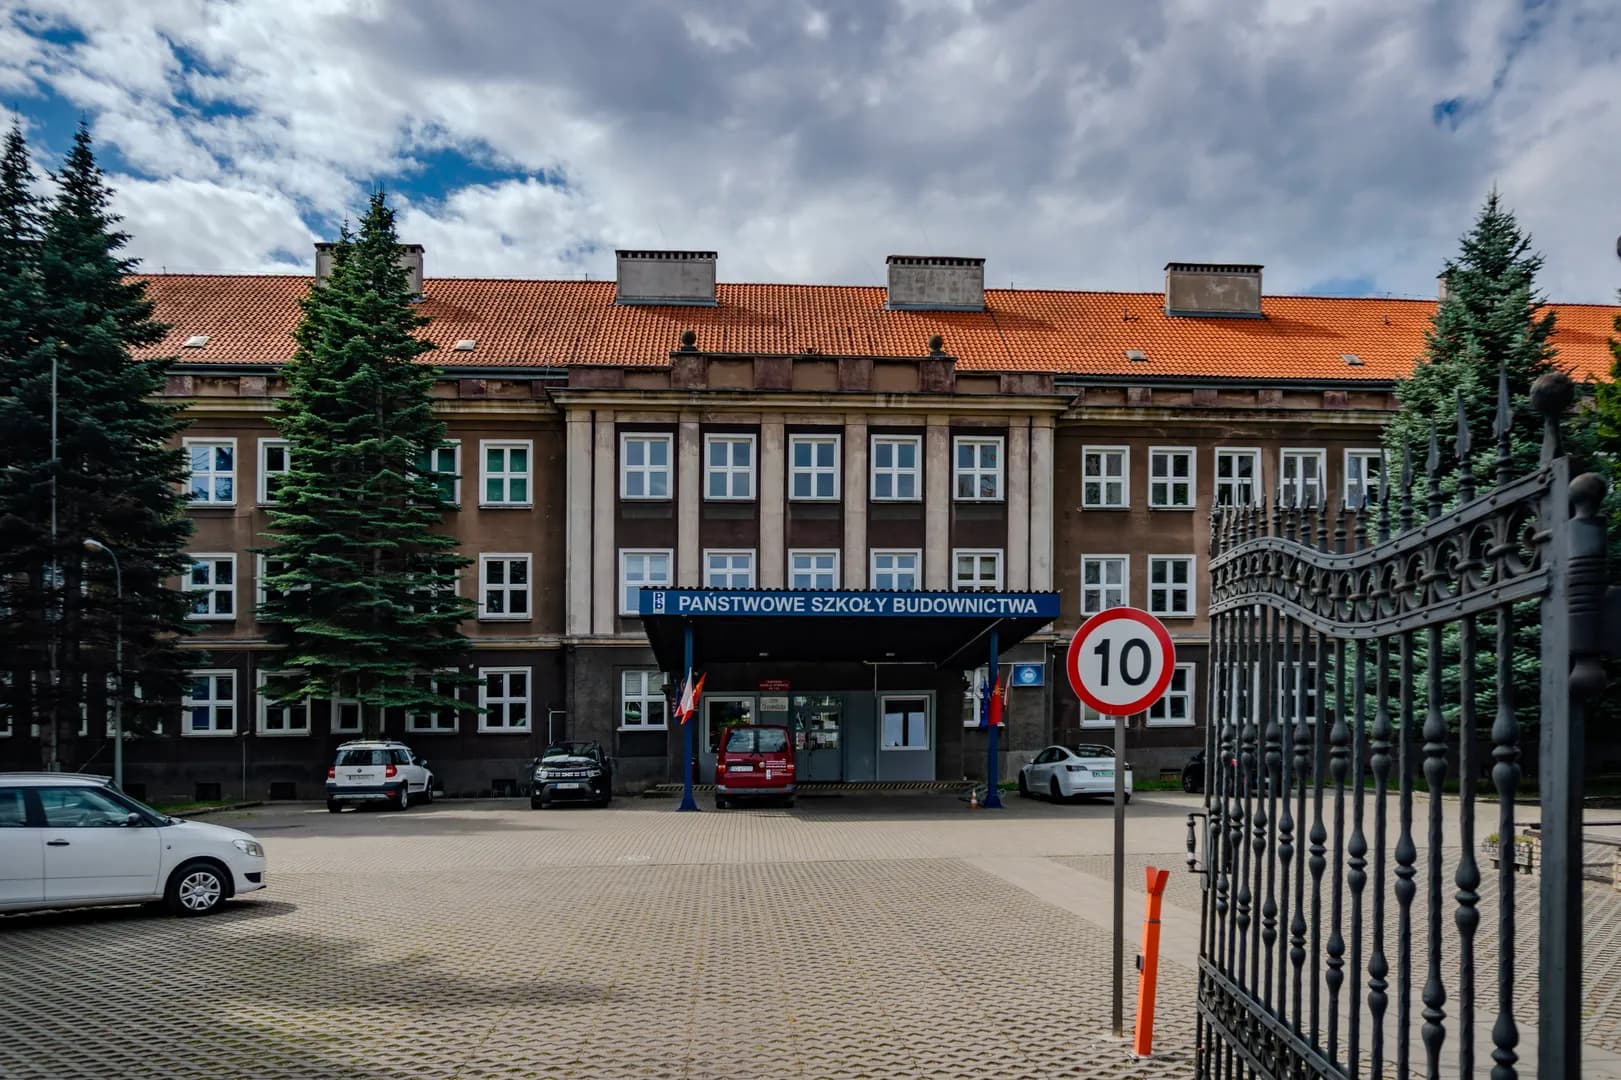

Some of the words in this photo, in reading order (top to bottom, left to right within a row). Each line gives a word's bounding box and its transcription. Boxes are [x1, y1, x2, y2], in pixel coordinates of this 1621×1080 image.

[678, 592, 806, 612] PAŃSTWOWE
[811, 597, 887, 613] SZKOŁY
[893, 597, 1038, 614] BUDOWNICTWA
[1094, 638, 1152, 686] 10
